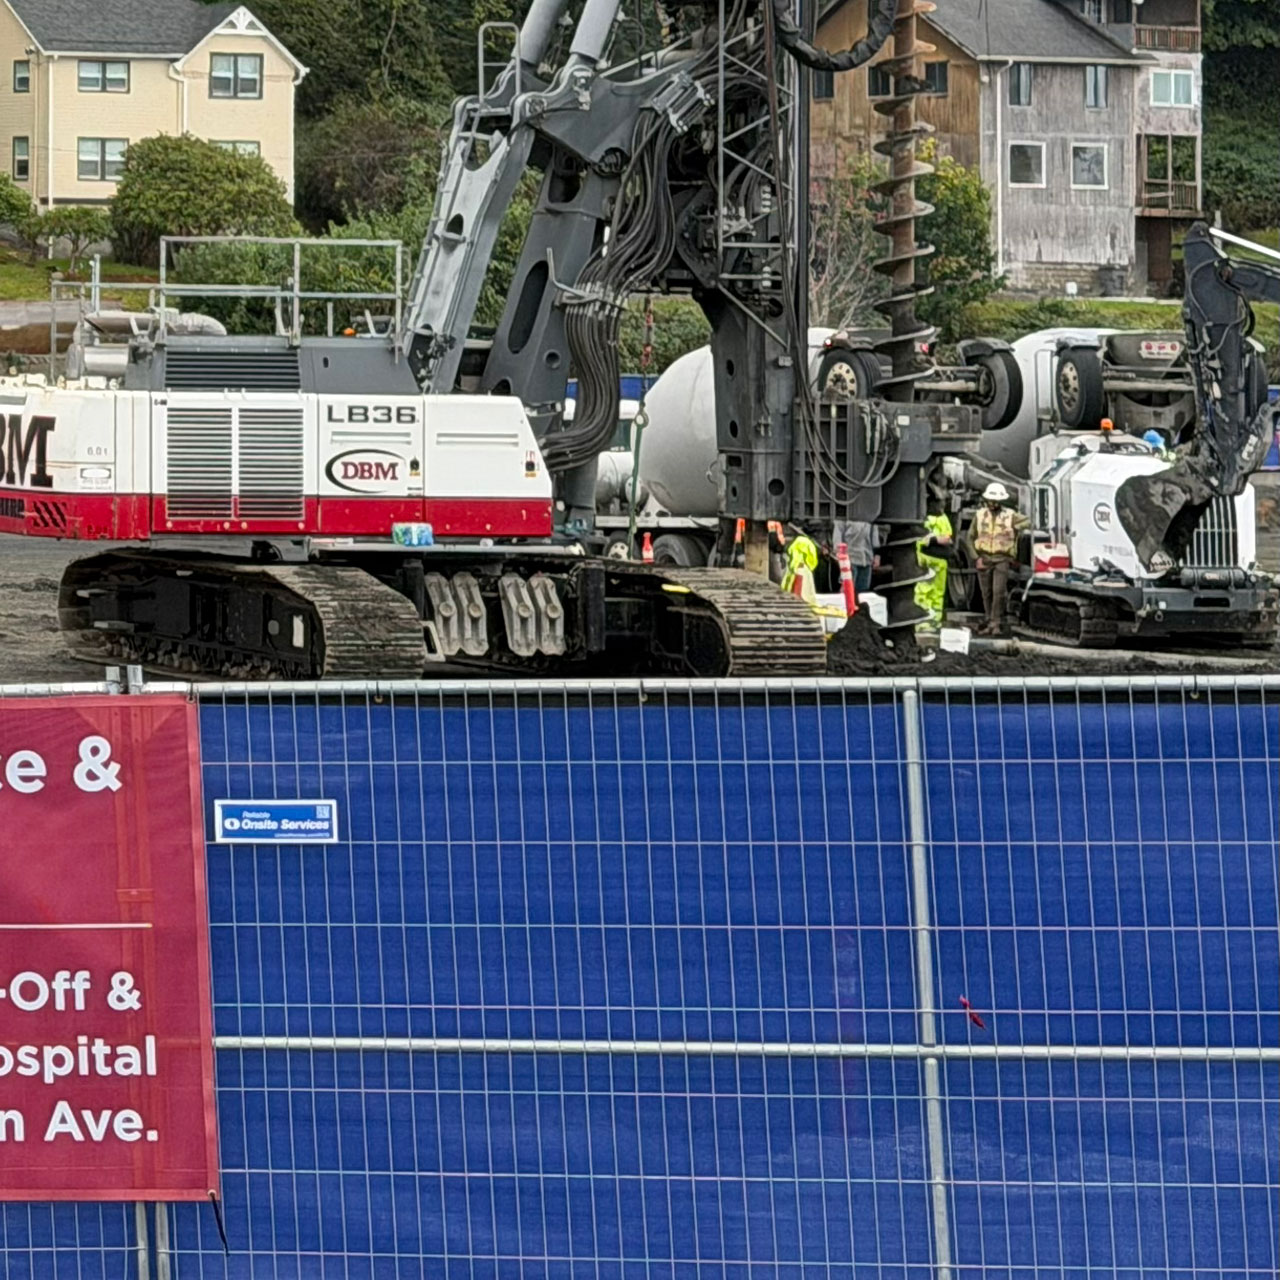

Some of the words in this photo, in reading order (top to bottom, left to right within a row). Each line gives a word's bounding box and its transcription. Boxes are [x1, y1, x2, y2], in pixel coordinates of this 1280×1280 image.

[327, 404, 417, 424] LB36
[340, 461, 399, 481] DBM
[73, 735, 123, 792] &
[241, 819, 279, 830] Onsite
[280, 819, 330, 830] Services
[107, 971, 142, 1011] &
[44, 1100, 159, 1143] Ave.
